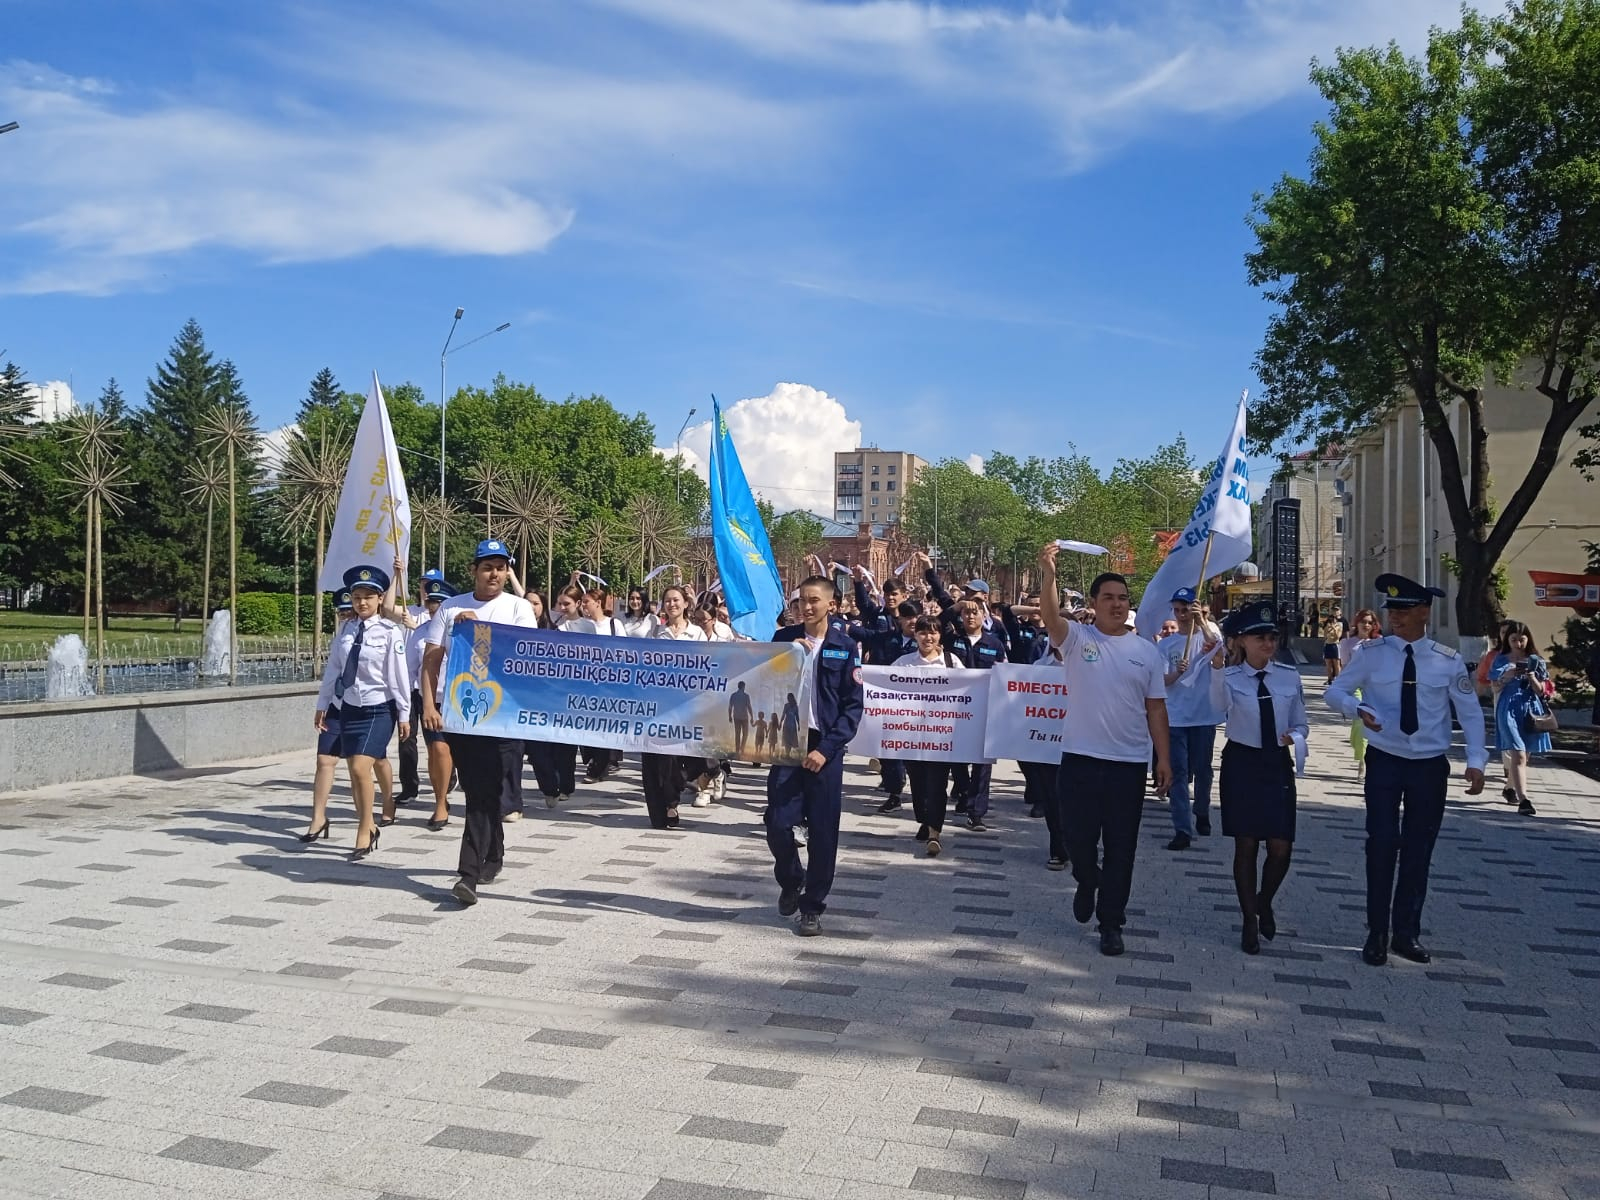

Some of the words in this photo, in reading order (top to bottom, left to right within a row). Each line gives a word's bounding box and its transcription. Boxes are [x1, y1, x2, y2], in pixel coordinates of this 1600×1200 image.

[516, 640, 639, 665] ОТБАСЫНДАҒЫ
[643, 652, 719, 673] ЗОРЛЫҚ-
[503, 659, 631, 684] ЗОМБЫЛЫҚСЫЗ
[635, 670, 728, 692] ҚАЗАҚСТАН
[889, 673, 949, 686] Солтүстік
[866, 689, 972, 704] Қазақстандықтар
[567, 695, 657, 717] КАЗАХСТАН
[863, 707, 926, 718] тұрмыстық
[928, 709, 974, 721] зорлық-
[517, 710, 549, 726] БЕЗ
[552, 714, 629, 735] НАСИЛИЯ
[633, 721, 644, 736] В
[647, 722, 704, 741] СЕМЬЕ
[882, 722, 953, 734] зомбылыққа
[1029, 728, 1047, 741] Ты
[881, 739, 953, 752] қарсымыз!
